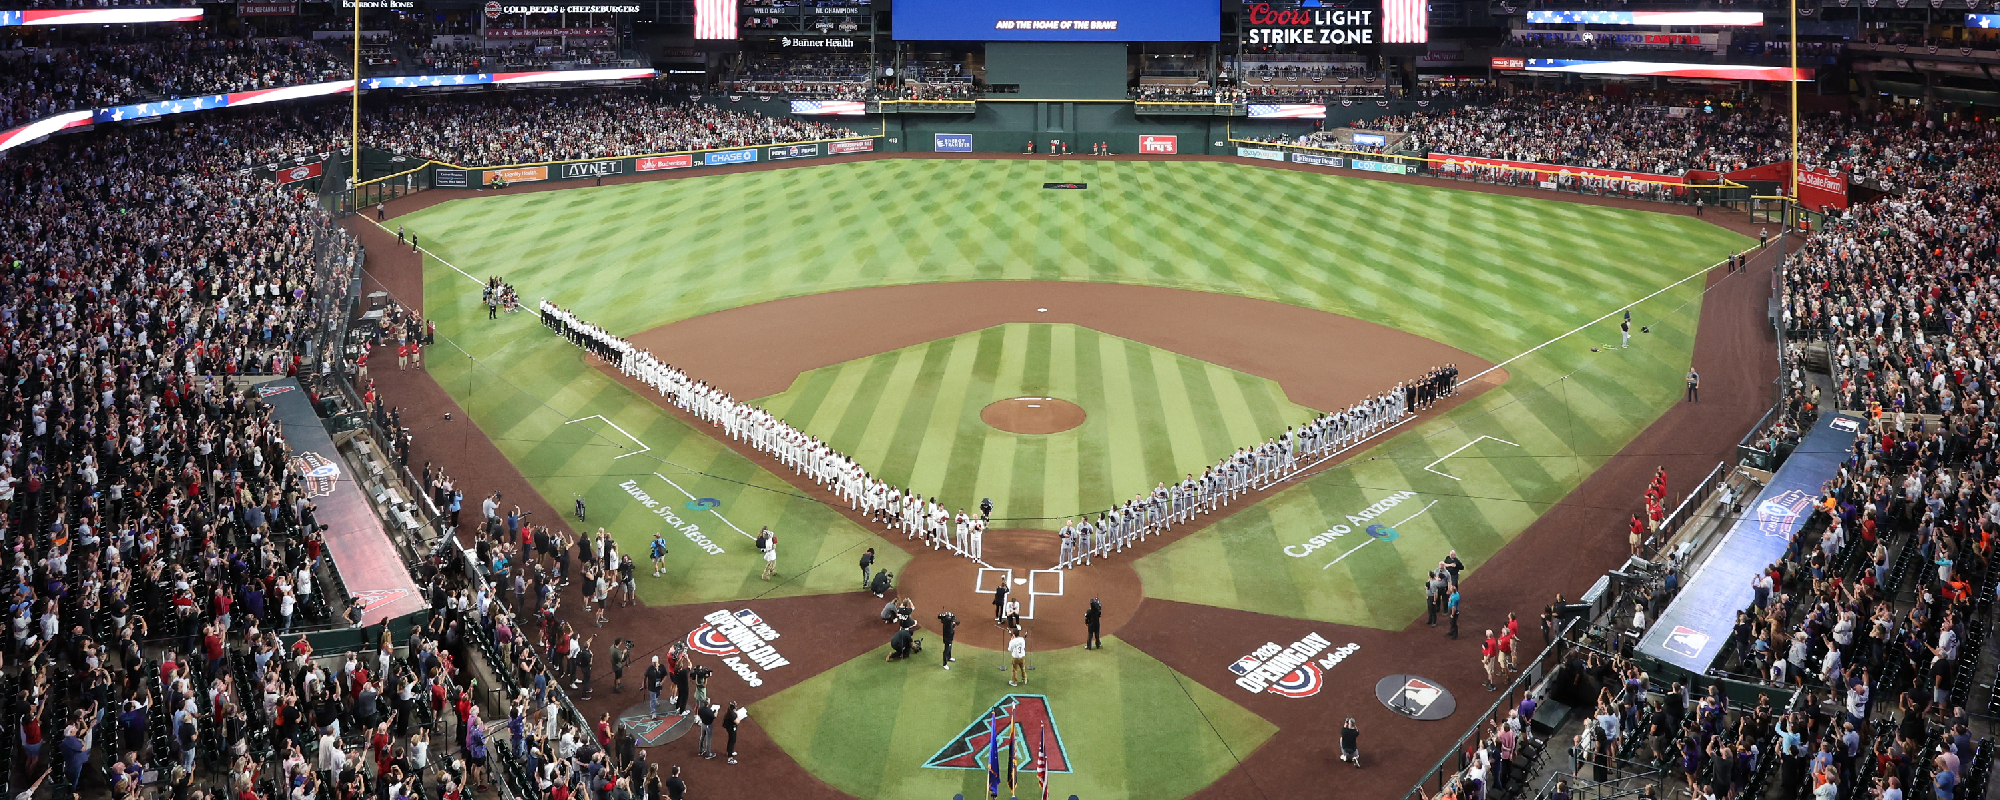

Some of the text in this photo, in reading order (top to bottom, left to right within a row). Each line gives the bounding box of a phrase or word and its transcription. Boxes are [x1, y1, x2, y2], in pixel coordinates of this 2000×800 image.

[390, 0, 414, 8] BONES
[503, 5, 527, 14] COLD
[529, 5, 559, 14] BEERS
[566, 5, 640, 14] CHEESEBURGERS
[1249, 2, 1373, 26] Coors LIGHT
[996, 20, 1118, 30] AND THE HOME OF THE BRAVE
[792, 38, 854, 48] Banner Health
[1249, 28, 1373, 44] STRIKE ZONE
[1142, 136, 1174, 152] fry's
[657, 159, 687, 168] Budweiser
[711, 152, 743, 163] CHASE
[1358, 161, 1376, 169] COX
[569, 161, 617, 176] AVNET
[1381, 164, 1399, 172] COX
[1806, 174, 1841, 191] State Farm
[618, 478, 726, 556] TALKING STICK RESORT
[1283, 490, 1418, 558] CASINO ARIZONA
[703, 608, 791, 671] OPENING DAY
[751, 622, 781, 641] 2026
[1251, 641, 1283, 662] 2026
[1318, 642, 1361, 671] Adobe
[1235, 631, 1332, 694] OPENING DAY
[721, 656, 764, 688] Adobe
